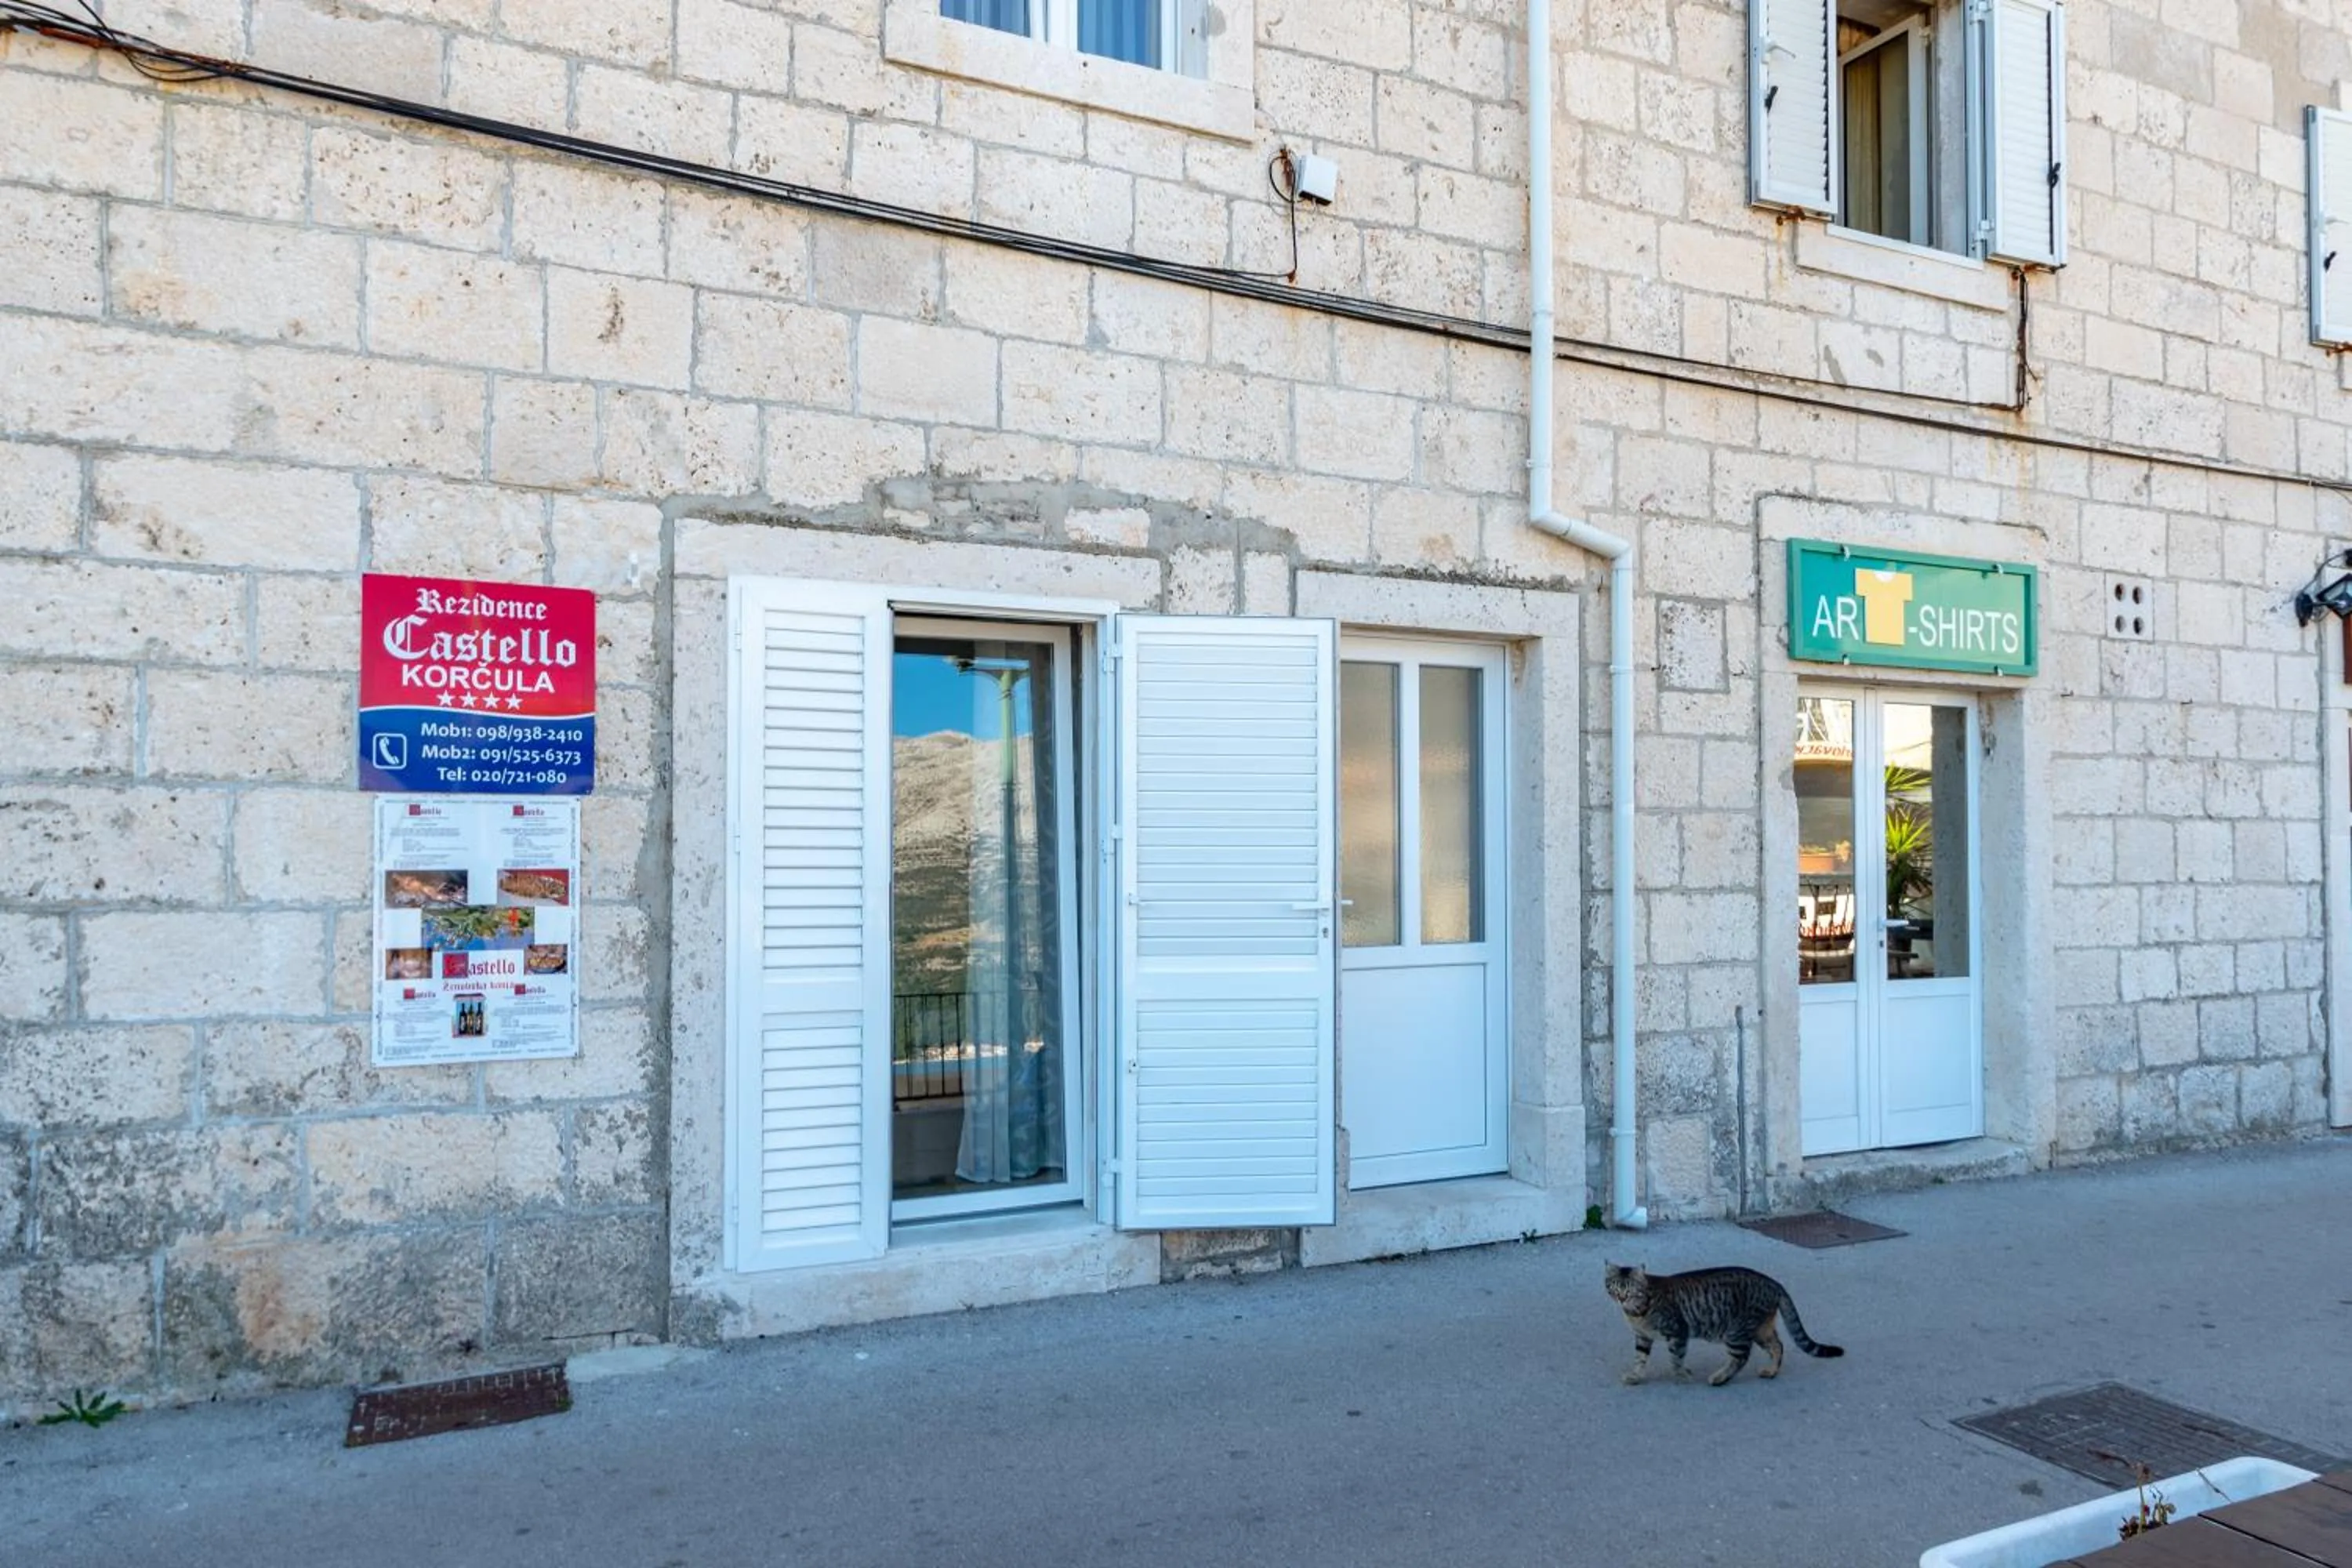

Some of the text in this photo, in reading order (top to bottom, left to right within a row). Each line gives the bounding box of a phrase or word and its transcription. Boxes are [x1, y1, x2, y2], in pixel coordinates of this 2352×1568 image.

[416, 587, 548, 620] Rezidence
[383, 614, 577, 667] Castello
[401, 661, 555, 693] KORČULA
[420, 722, 583, 744] Mob1: 098/938-2410
[421, 744, 582, 765] Mob2: 091/525-6373
[436, 767, 567, 785] Tel: 020/721-080
